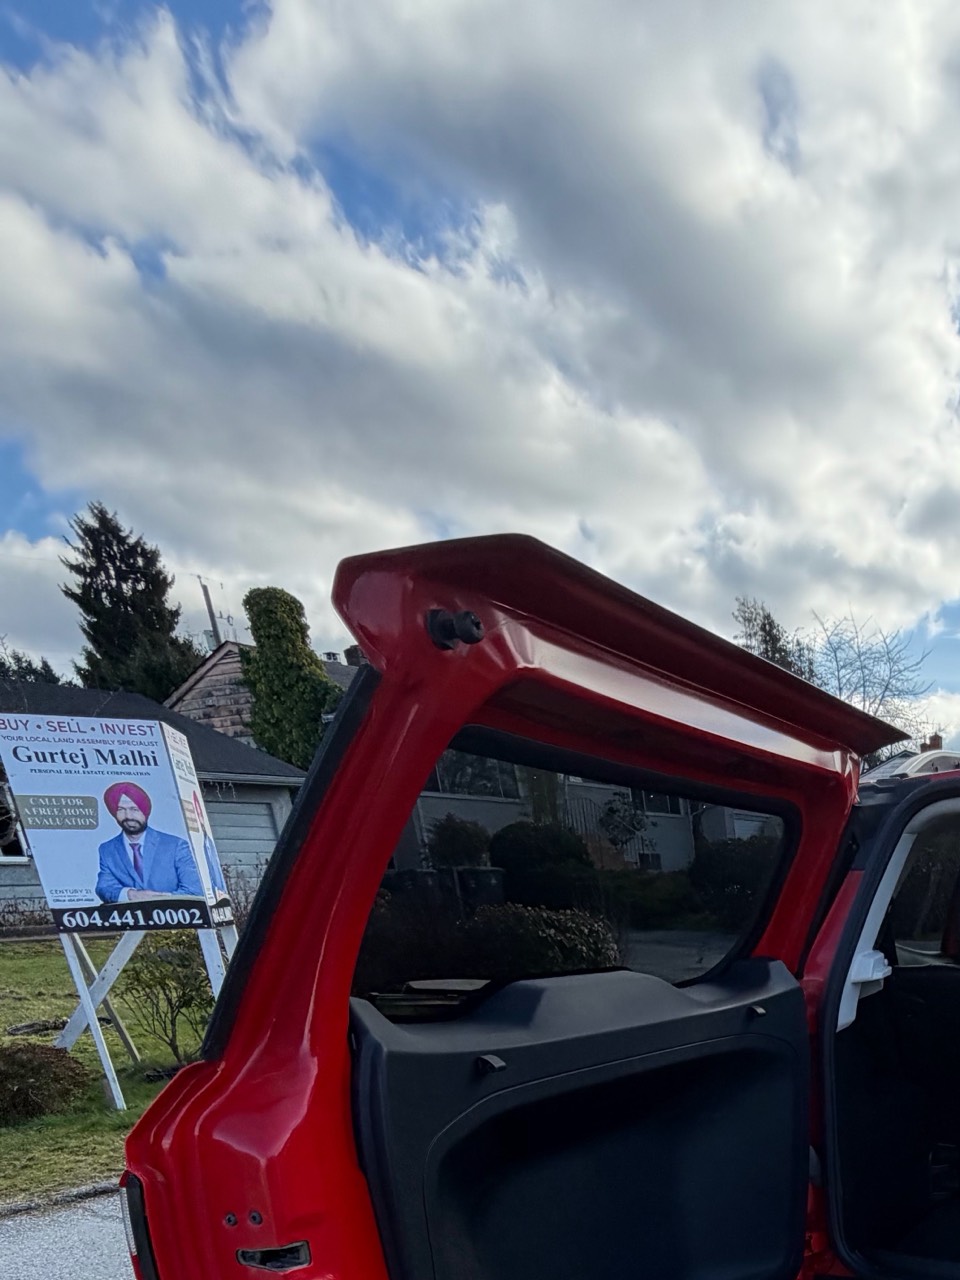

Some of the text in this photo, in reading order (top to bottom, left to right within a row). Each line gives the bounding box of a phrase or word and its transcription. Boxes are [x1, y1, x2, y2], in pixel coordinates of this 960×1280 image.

[0, 719, 156, 736] BUY SELL INVEST
[12, 745, 89, 769] Gurtej
[94, 748, 159, 767] Malhi
[29, 797, 84, 806] CALL FOR
[24, 807, 96, 816] A FREE HOME
[27, 817, 97, 826] EVALUATION
[62, 908, 204, 928] 604.441.0002
